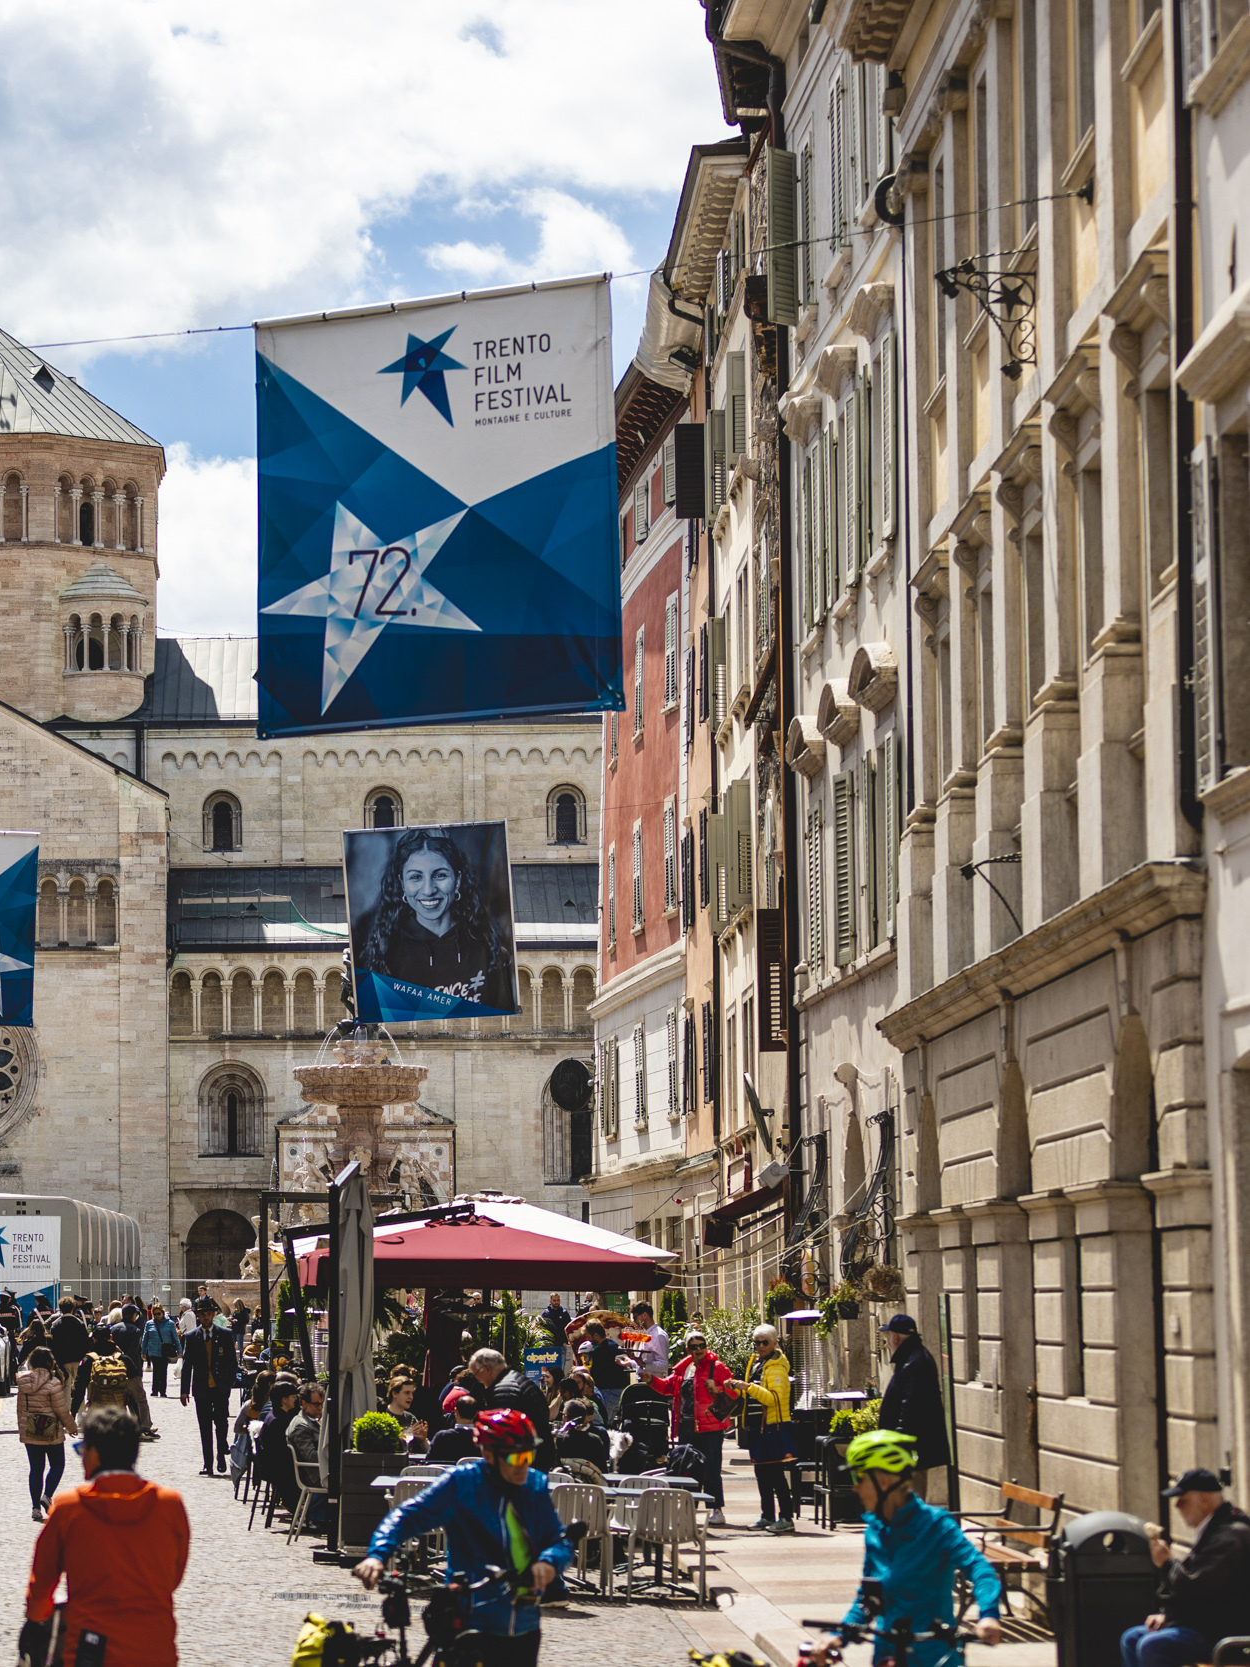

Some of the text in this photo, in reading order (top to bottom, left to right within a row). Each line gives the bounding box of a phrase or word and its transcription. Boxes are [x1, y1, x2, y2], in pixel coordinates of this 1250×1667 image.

[473, 333, 551, 361] TRENTO
[475, 362, 522, 387] FILM
[475, 383, 572, 412] FESTIVAL
[475, 408, 573, 427] MONTAGNE E CULTURE
[348, 547, 417, 618] 72.
[393, 982, 423, 998] WAFAA
[426, 993, 452, 1006] AMER
[12, 1233, 44, 1242] TRENTO
[12, 1244, 33, 1253] FILM
[12, 1254, 51, 1263] FESTIVAL
